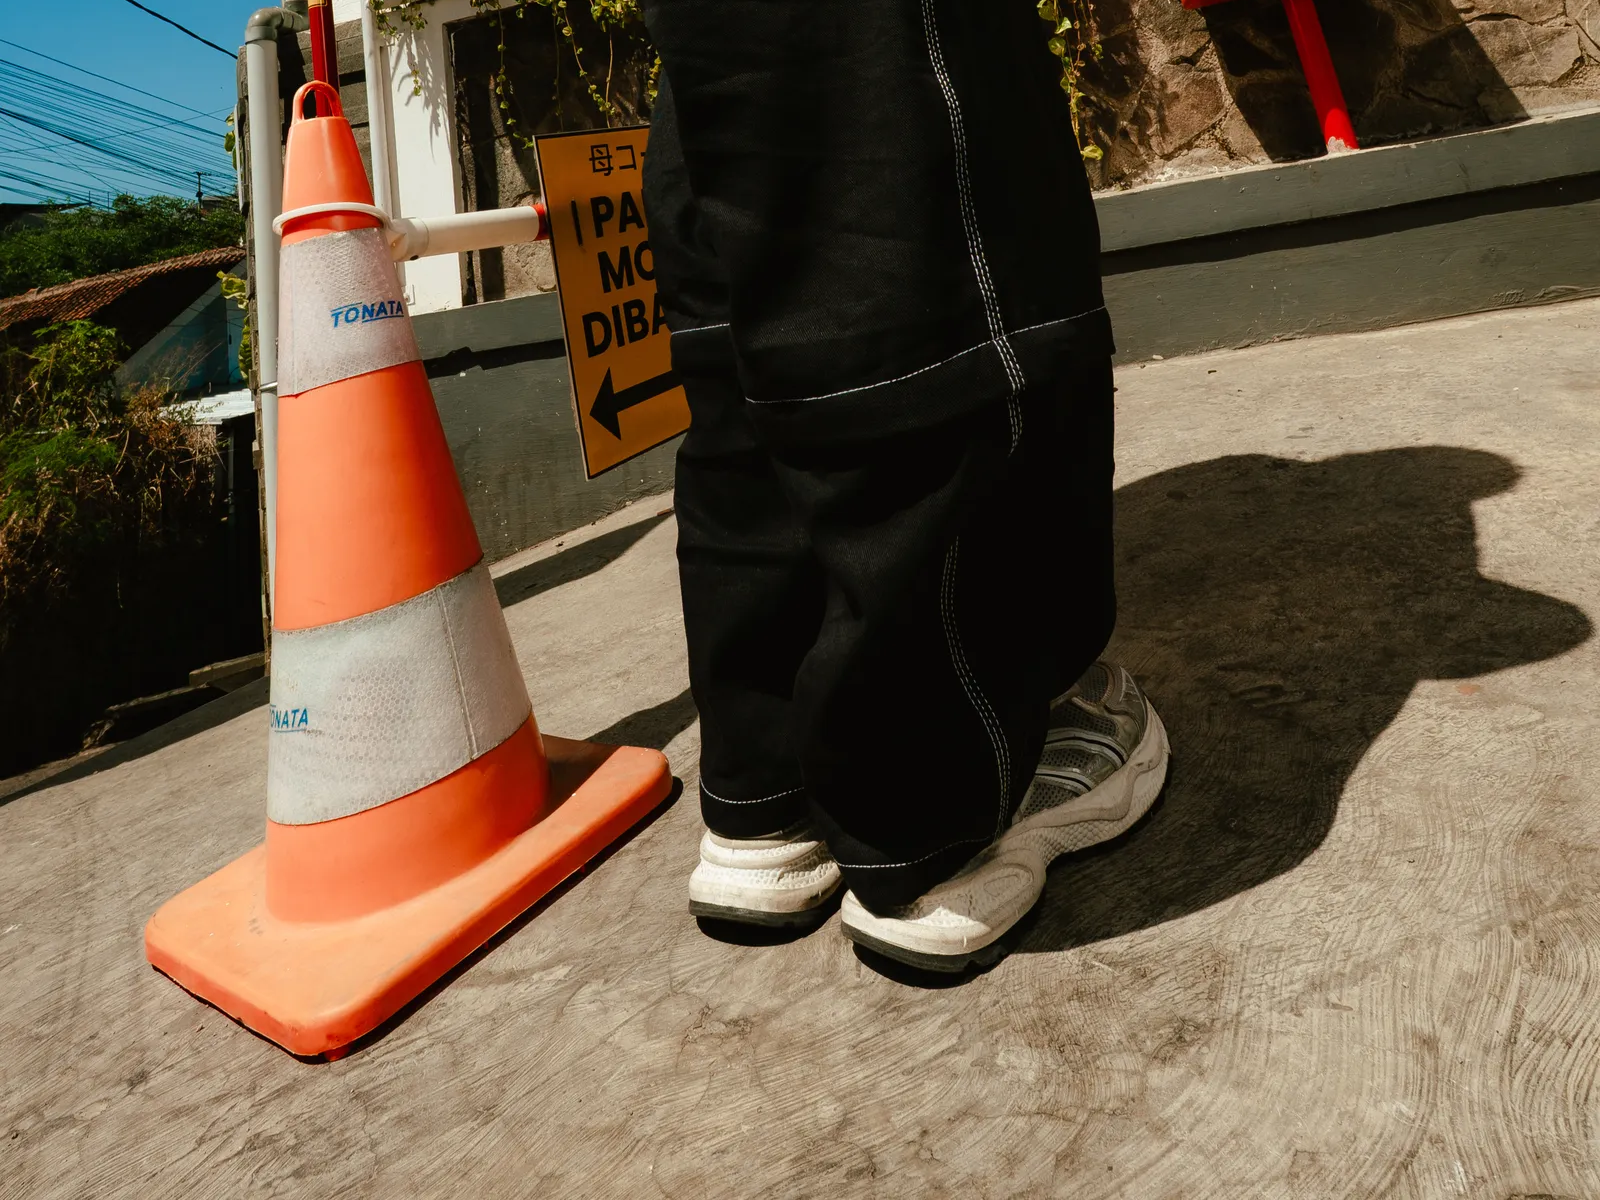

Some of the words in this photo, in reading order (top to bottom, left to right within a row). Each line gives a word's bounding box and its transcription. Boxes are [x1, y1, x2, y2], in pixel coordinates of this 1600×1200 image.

[589, 143, 646, 176] 母コ
[591, 189, 649, 238] PA
[330, 301, 404, 328] TONATA
